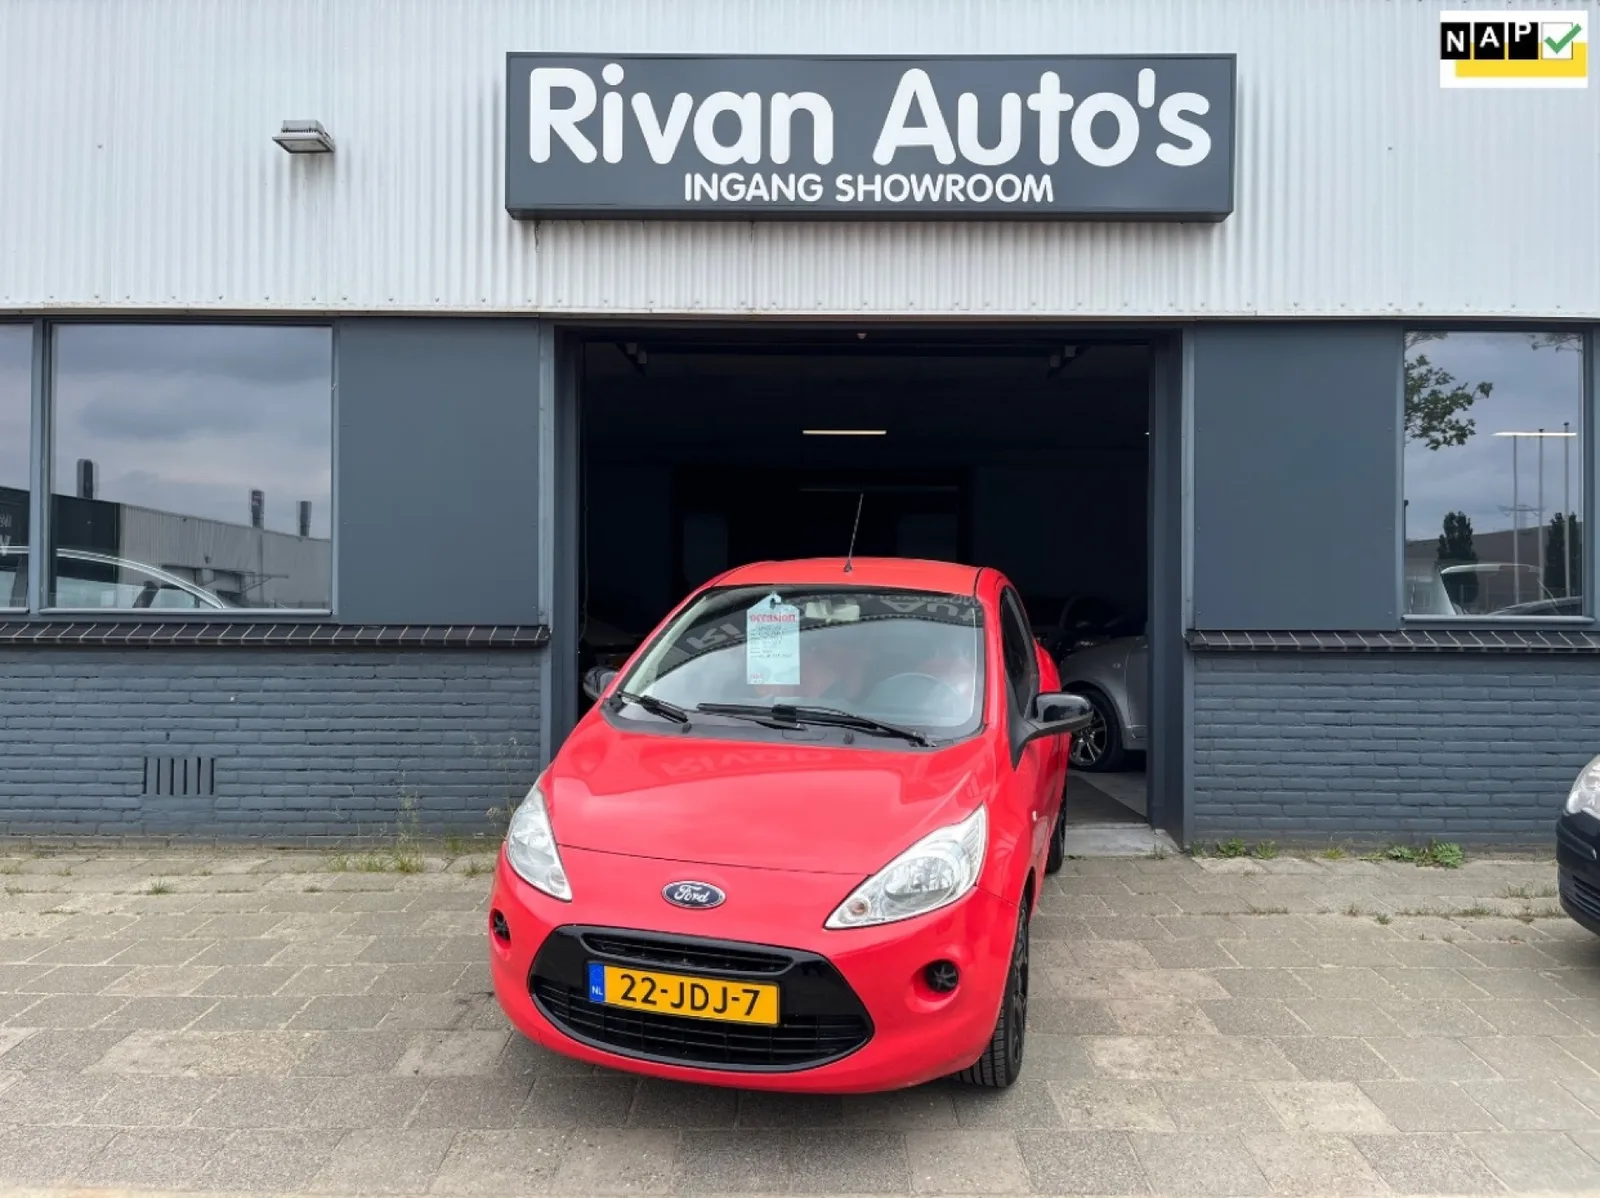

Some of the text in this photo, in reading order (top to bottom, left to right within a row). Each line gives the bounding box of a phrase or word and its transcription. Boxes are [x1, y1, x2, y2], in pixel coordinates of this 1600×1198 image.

[529, 62, 1212, 167] Rivan Auto's
[684, 172, 1054, 204] INGANG SHOWROOM
[750, 611, 796, 623] occasion
[673, 885, 710, 903] Ford
[591, 985, 603, 996] NL
[620, 973, 761, 1017] 22-JDJ-7
